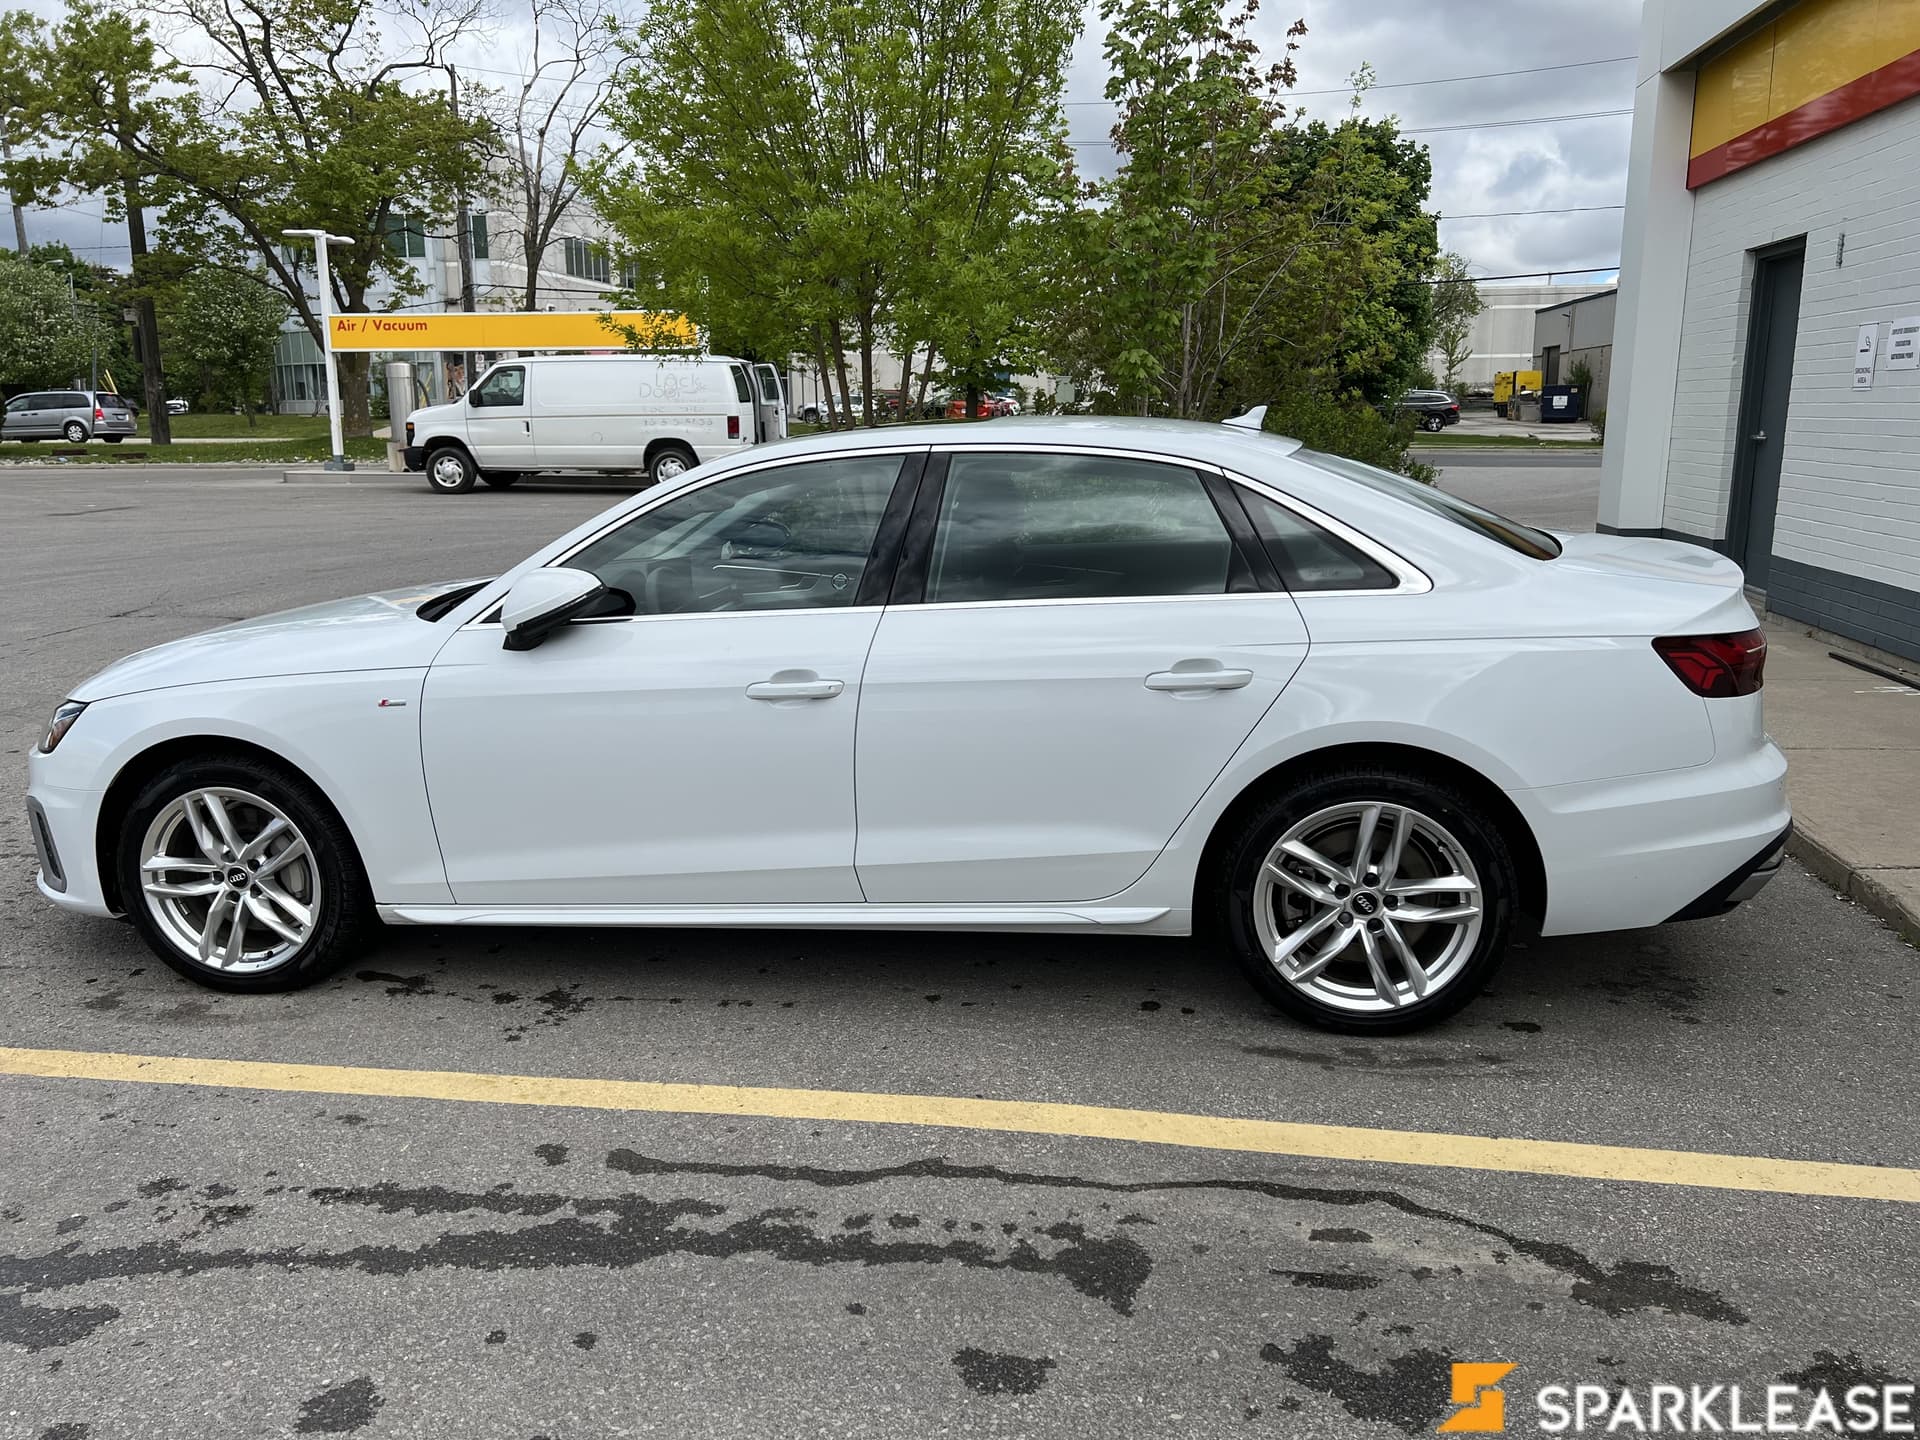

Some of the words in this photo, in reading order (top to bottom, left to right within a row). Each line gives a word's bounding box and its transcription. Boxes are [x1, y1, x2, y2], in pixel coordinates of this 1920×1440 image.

[337, 319, 356, 331] Air
[361, 318, 368, 332] /
[373, 319, 428, 331] Vacuum
